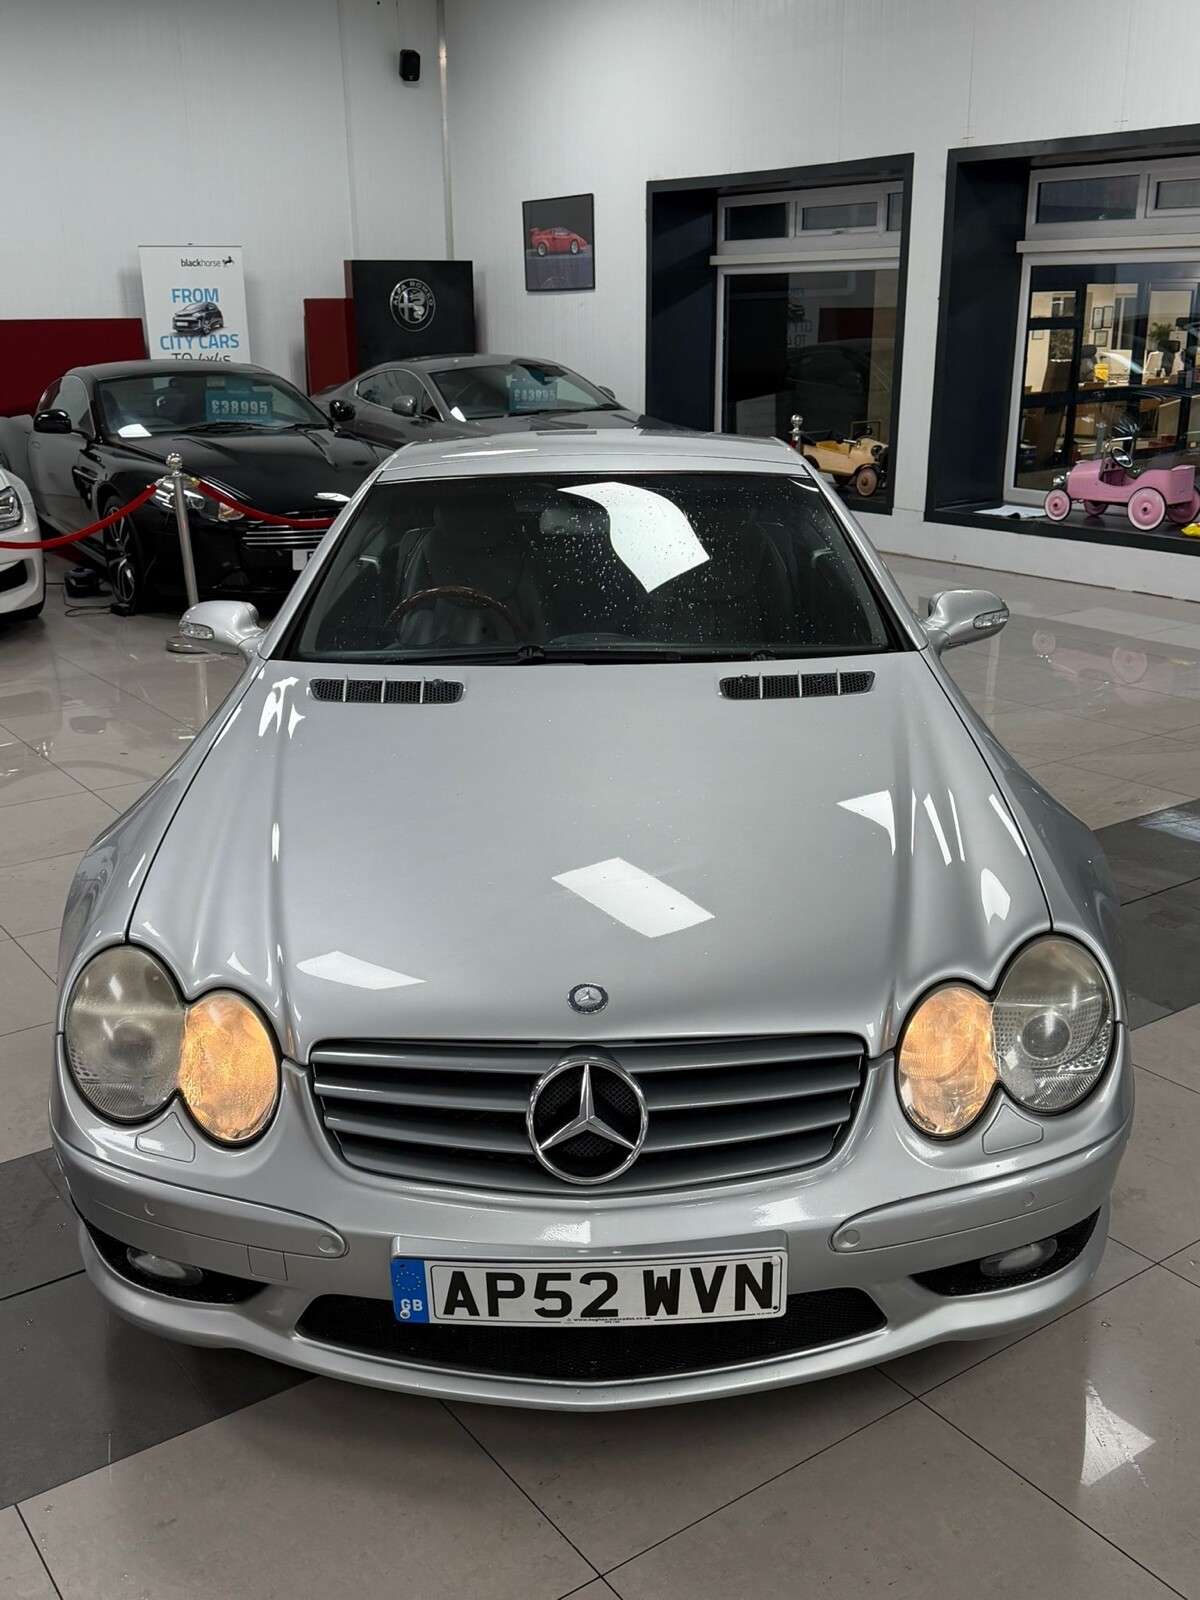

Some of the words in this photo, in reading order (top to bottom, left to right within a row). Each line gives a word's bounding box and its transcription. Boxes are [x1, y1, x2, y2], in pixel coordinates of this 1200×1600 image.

[180, 258, 221, 267] blackhorse
[171, 288, 220, 303] FROM
[160, 335, 194, 350] CITY
[199, 333, 240, 349] CARS
[211, 400, 268, 415] £38995
[443, 1270, 619, 1318] AP52
[642, 1262, 773, 1316] WVN
[400, 1299, 423, 1311] GB
